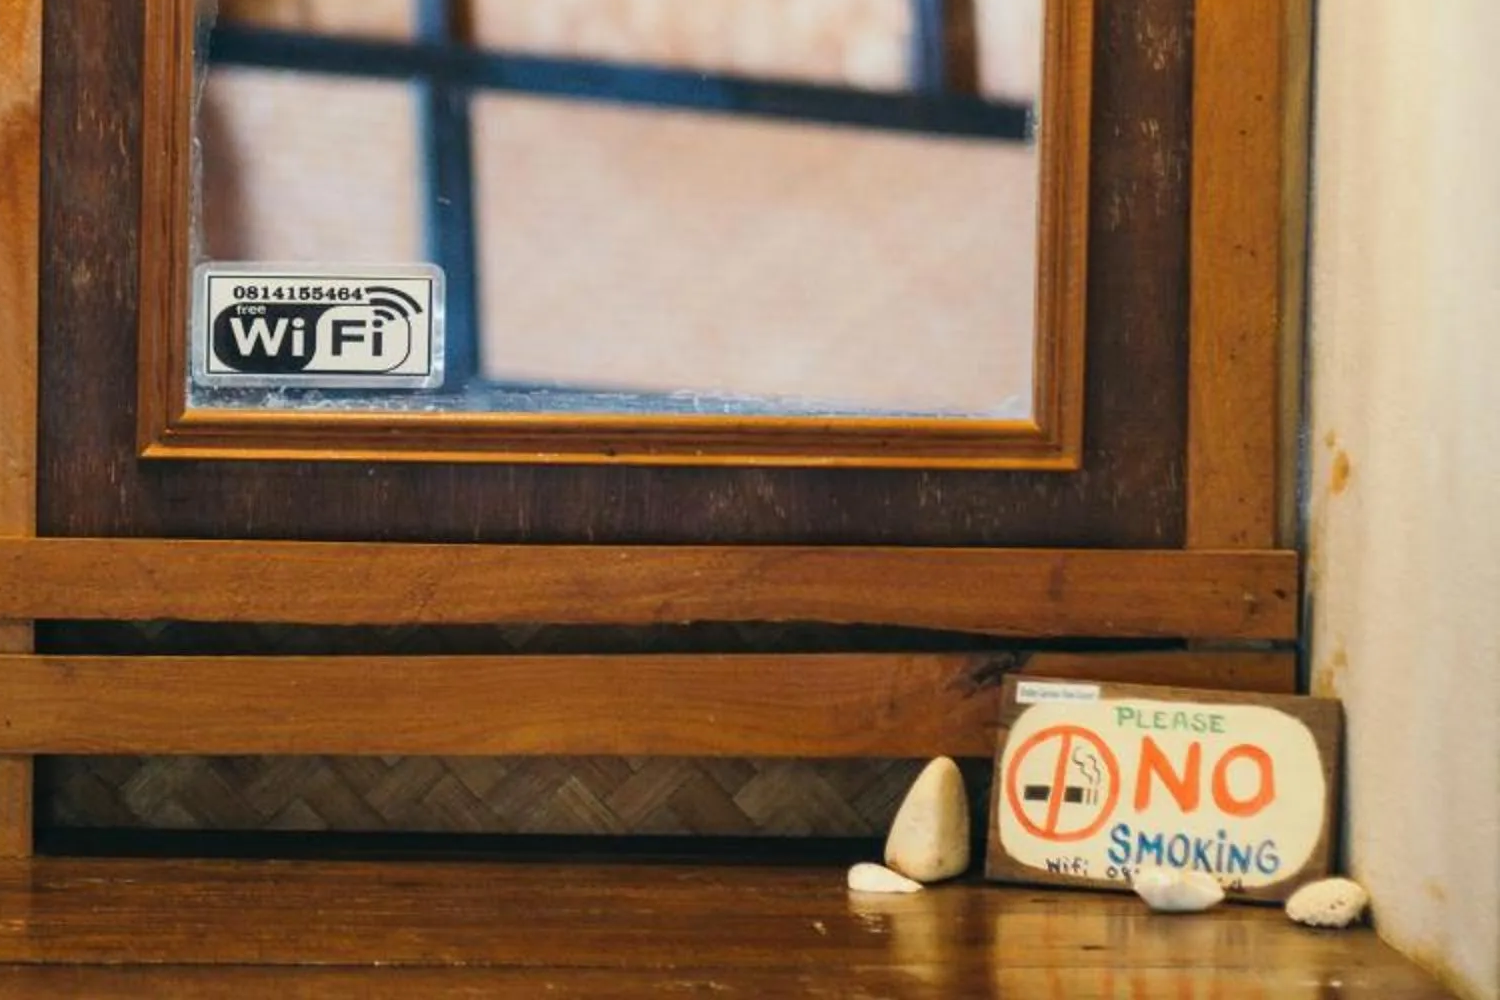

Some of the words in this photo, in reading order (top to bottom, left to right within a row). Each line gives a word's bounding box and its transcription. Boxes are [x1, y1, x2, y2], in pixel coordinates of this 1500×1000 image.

[233, 286, 363, 301] 0814155464
[236, 305, 267, 315] free
[1115, 706, 1226, 734] PLEASE
[1134, 735, 1276, 819] NO
